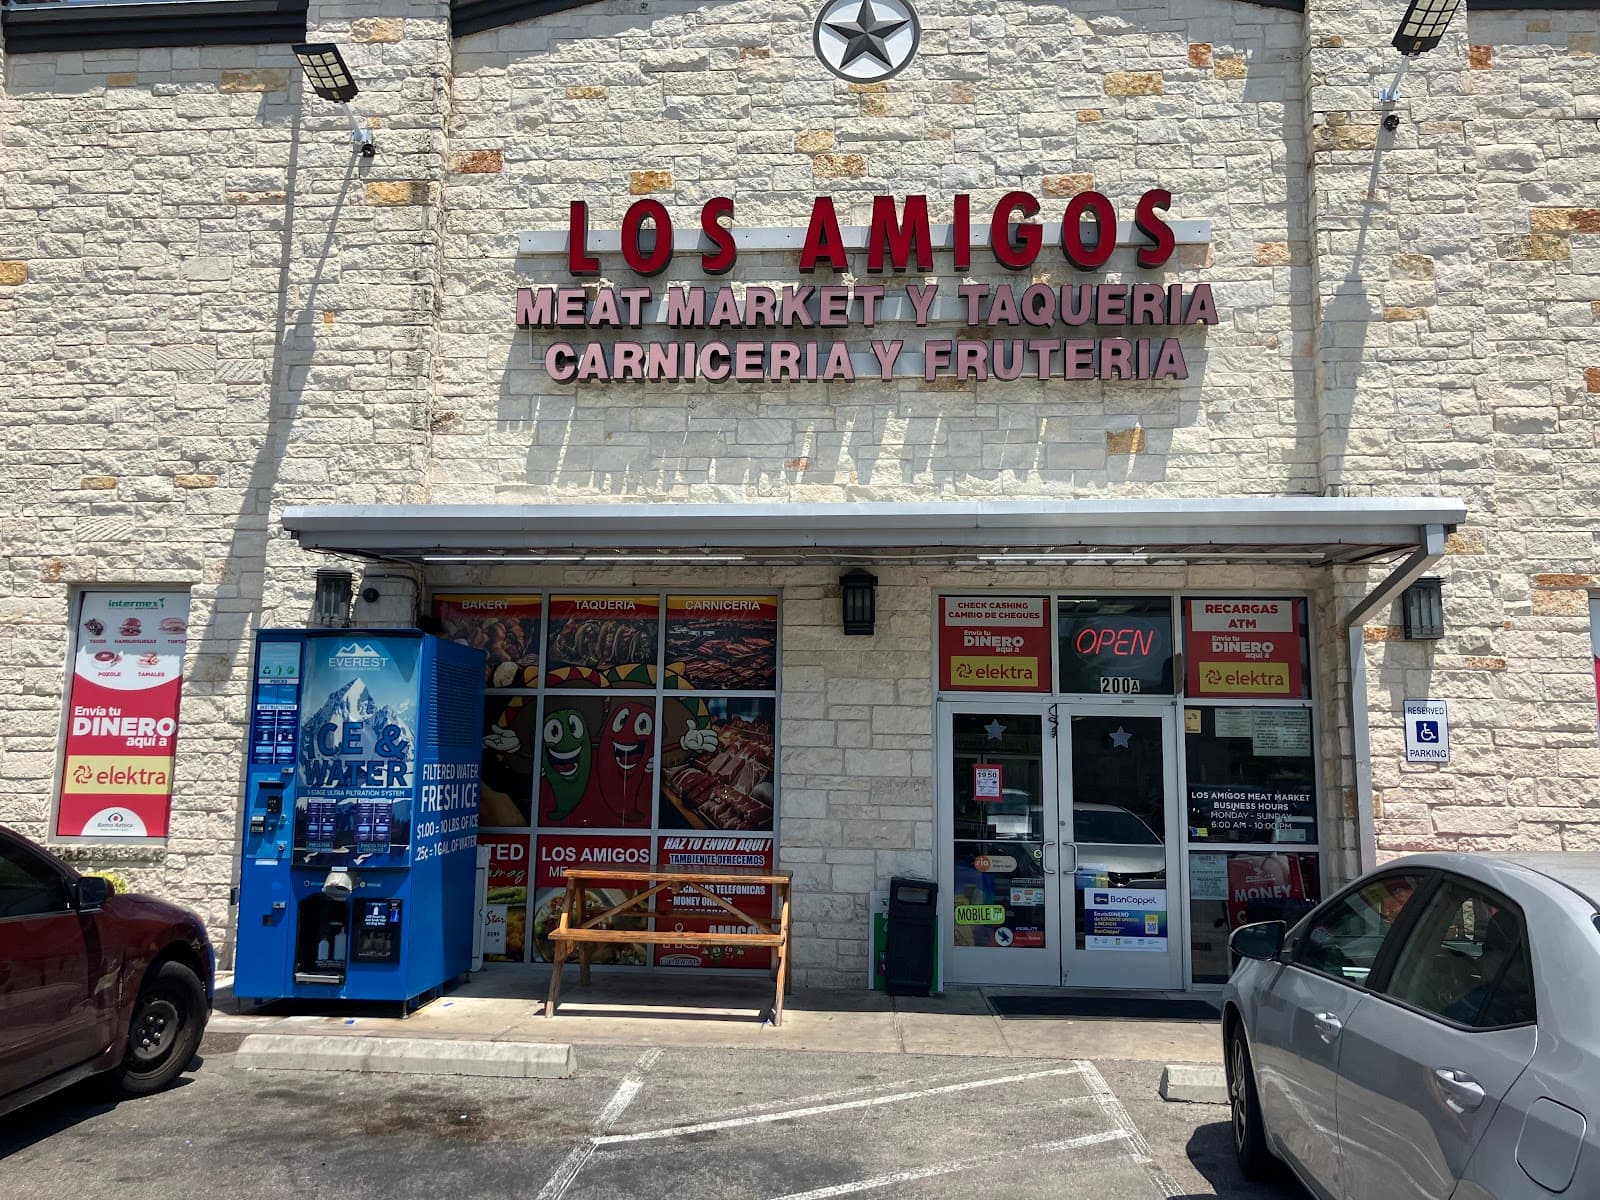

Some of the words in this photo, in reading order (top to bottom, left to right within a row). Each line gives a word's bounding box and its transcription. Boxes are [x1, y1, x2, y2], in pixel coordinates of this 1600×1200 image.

[568, 195, 738, 277] LOS
[799, 188, 1177, 274] AMIGOS
[515, 286, 652, 329] MEAT
[668, 285, 886, 329] MARKET
[906, 284, 939, 327] Y
[958, 283, 1219, 327] TAQUERIA
[544, 340, 857, 384] CARNICERIA
[871, 338, 904, 381] Y
[923, 337, 1189, 382] FRUTERIA
[108, 597, 165, 608] intermex
[461, 599, 510, 610] BAKERY
[574, 600, 636, 611] TAQUERIA
[684, 600, 761, 611] CARNICERIA
[957, 602, 987, 610] CHECK
[989, 602, 1029, 610] CASHING
[1205, 604, 1279, 614] RECARGAS
[948, 611, 983, 619] CAMBIO
[984, 611, 997, 619] DE
[998, 612, 1041, 620] CHEQUES
[1228, 619, 1257, 629] ATM
[963, 636, 1025, 647] DINERO
[1076, 628, 1155, 656] OPEN
[1212, 642, 1275, 653] DINERO
[328, 657, 389, 669] EVEREST
[975, 664, 1033, 680] elektra
[1225, 670, 1284, 686] elektra
[1102, 677, 1140, 694] 200A
[74, 705, 106, 716] Envía
[108, 706, 122, 716] tu
[1407, 706, 1445, 715] RESERVED
[72, 717, 177, 737] DINERO
[126, 735, 157, 749] aquí
[158, 737, 168, 747] a
[302, 721, 364, 760] ICE
[374, 724, 409, 758] &
[1410, 749, 1447, 758] PARKING
[96, 765, 167, 785] elektra
[304, 760, 408, 787] WATER
[422, 763, 456, 780] FILTERED
[456, 764, 479, 779] WATER
[420, 784, 459, 813] FRESH
[460, 783, 479, 809] ICE
[1191, 791, 1209, 799] LOS
[1210, 792, 1246, 800] AMIGOS
[1247, 793, 1273, 801] MEAT
[1213, 801, 1256, 810] BUSINESS
[1258, 803, 1289, 811] HOURS
[1210, 811, 1249, 819] MONDAY
[1256, 812, 1292, 820] SUNDAY
[416, 821, 435, 840] $1.00
[440, 819, 448, 834] 10
[461, 815, 470, 830] OF
[469, 814, 479, 828] ICE
[1211, 821, 1231, 829] 6:00
[1254, 822, 1277, 830] 10:00
[1279, 822, 1292, 830] PM
[451, 838, 460, 853] OF
[459, 834, 478, 850] WATER
[664, 837, 685, 849] HAZ
[687, 838, 702, 850] TU
[703, 838, 736, 851] ENVIO
[541, 847, 576, 862] LOS
[580, 847, 650, 863] AMIGOS
[670, 854, 706, 865] TAMBIEN
[706, 854, 716, 865] TE
[716, 854, 765, 866] OFRECEMOS
[976, 858, 989, 866] ria
[715, 884, 766, 895] TELEFONICAS
[1234, 885, 1292, 903] MONEY
[673, 896, 700, 906] MONEY
[1110, 895, 1157, 906] BanCoppel
[957, 907, 991, 921] MOBILE
